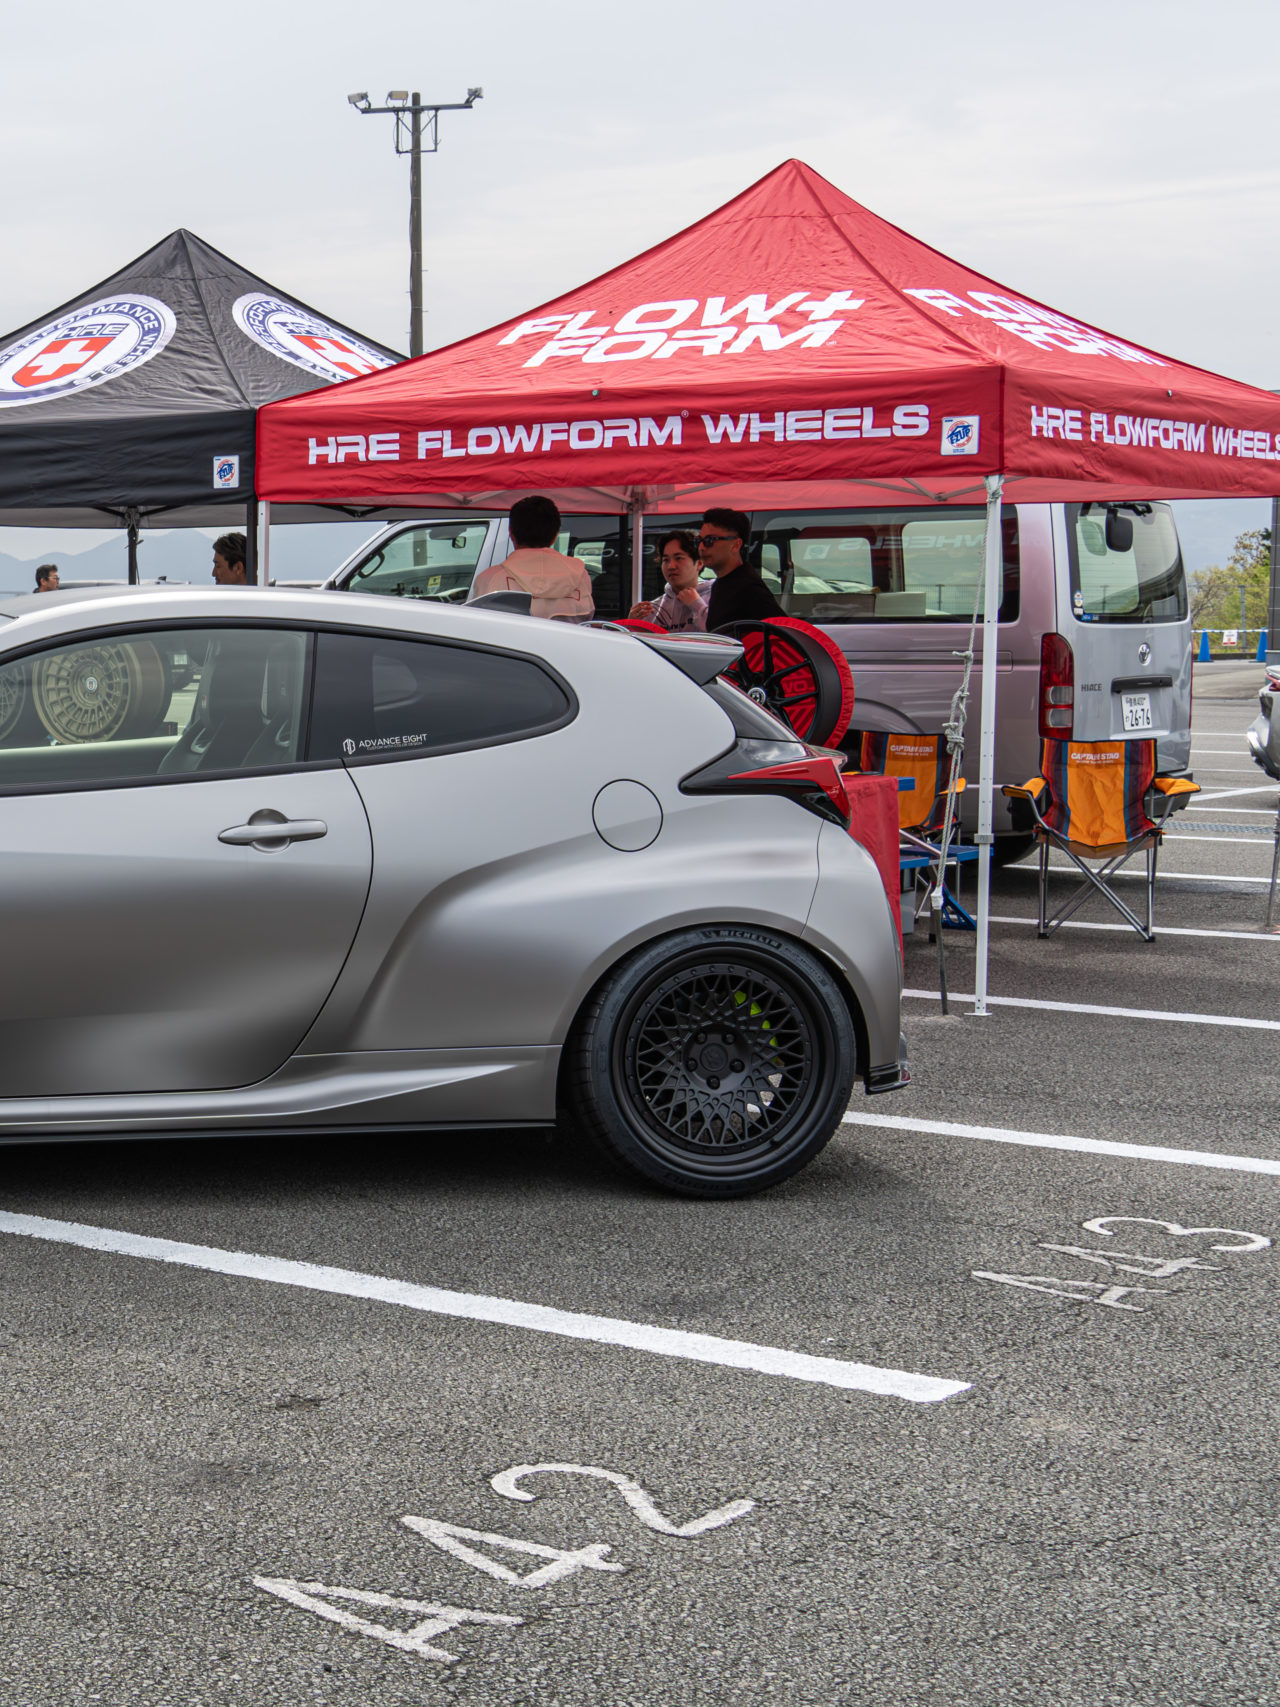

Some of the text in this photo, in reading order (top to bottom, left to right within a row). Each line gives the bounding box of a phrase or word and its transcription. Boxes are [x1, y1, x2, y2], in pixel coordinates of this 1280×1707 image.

[56, 322, 131, 340] HRE
[521, 319, 846, 368] FORM
[1030, 405, 1083, 441] HRE
[308, 432, 400, 465] HRE
[700, 404, 930, 444] WHEELS
[1081, 683, 1103, 692] HIACE
[358, 733, 428, 748] ADVANCE EIGHT
[1071, 752, 1100, 760] CAPTAIN
[720, 930, 781, 949] MICHELIN
[253, 1463, 756, 1663] A42
